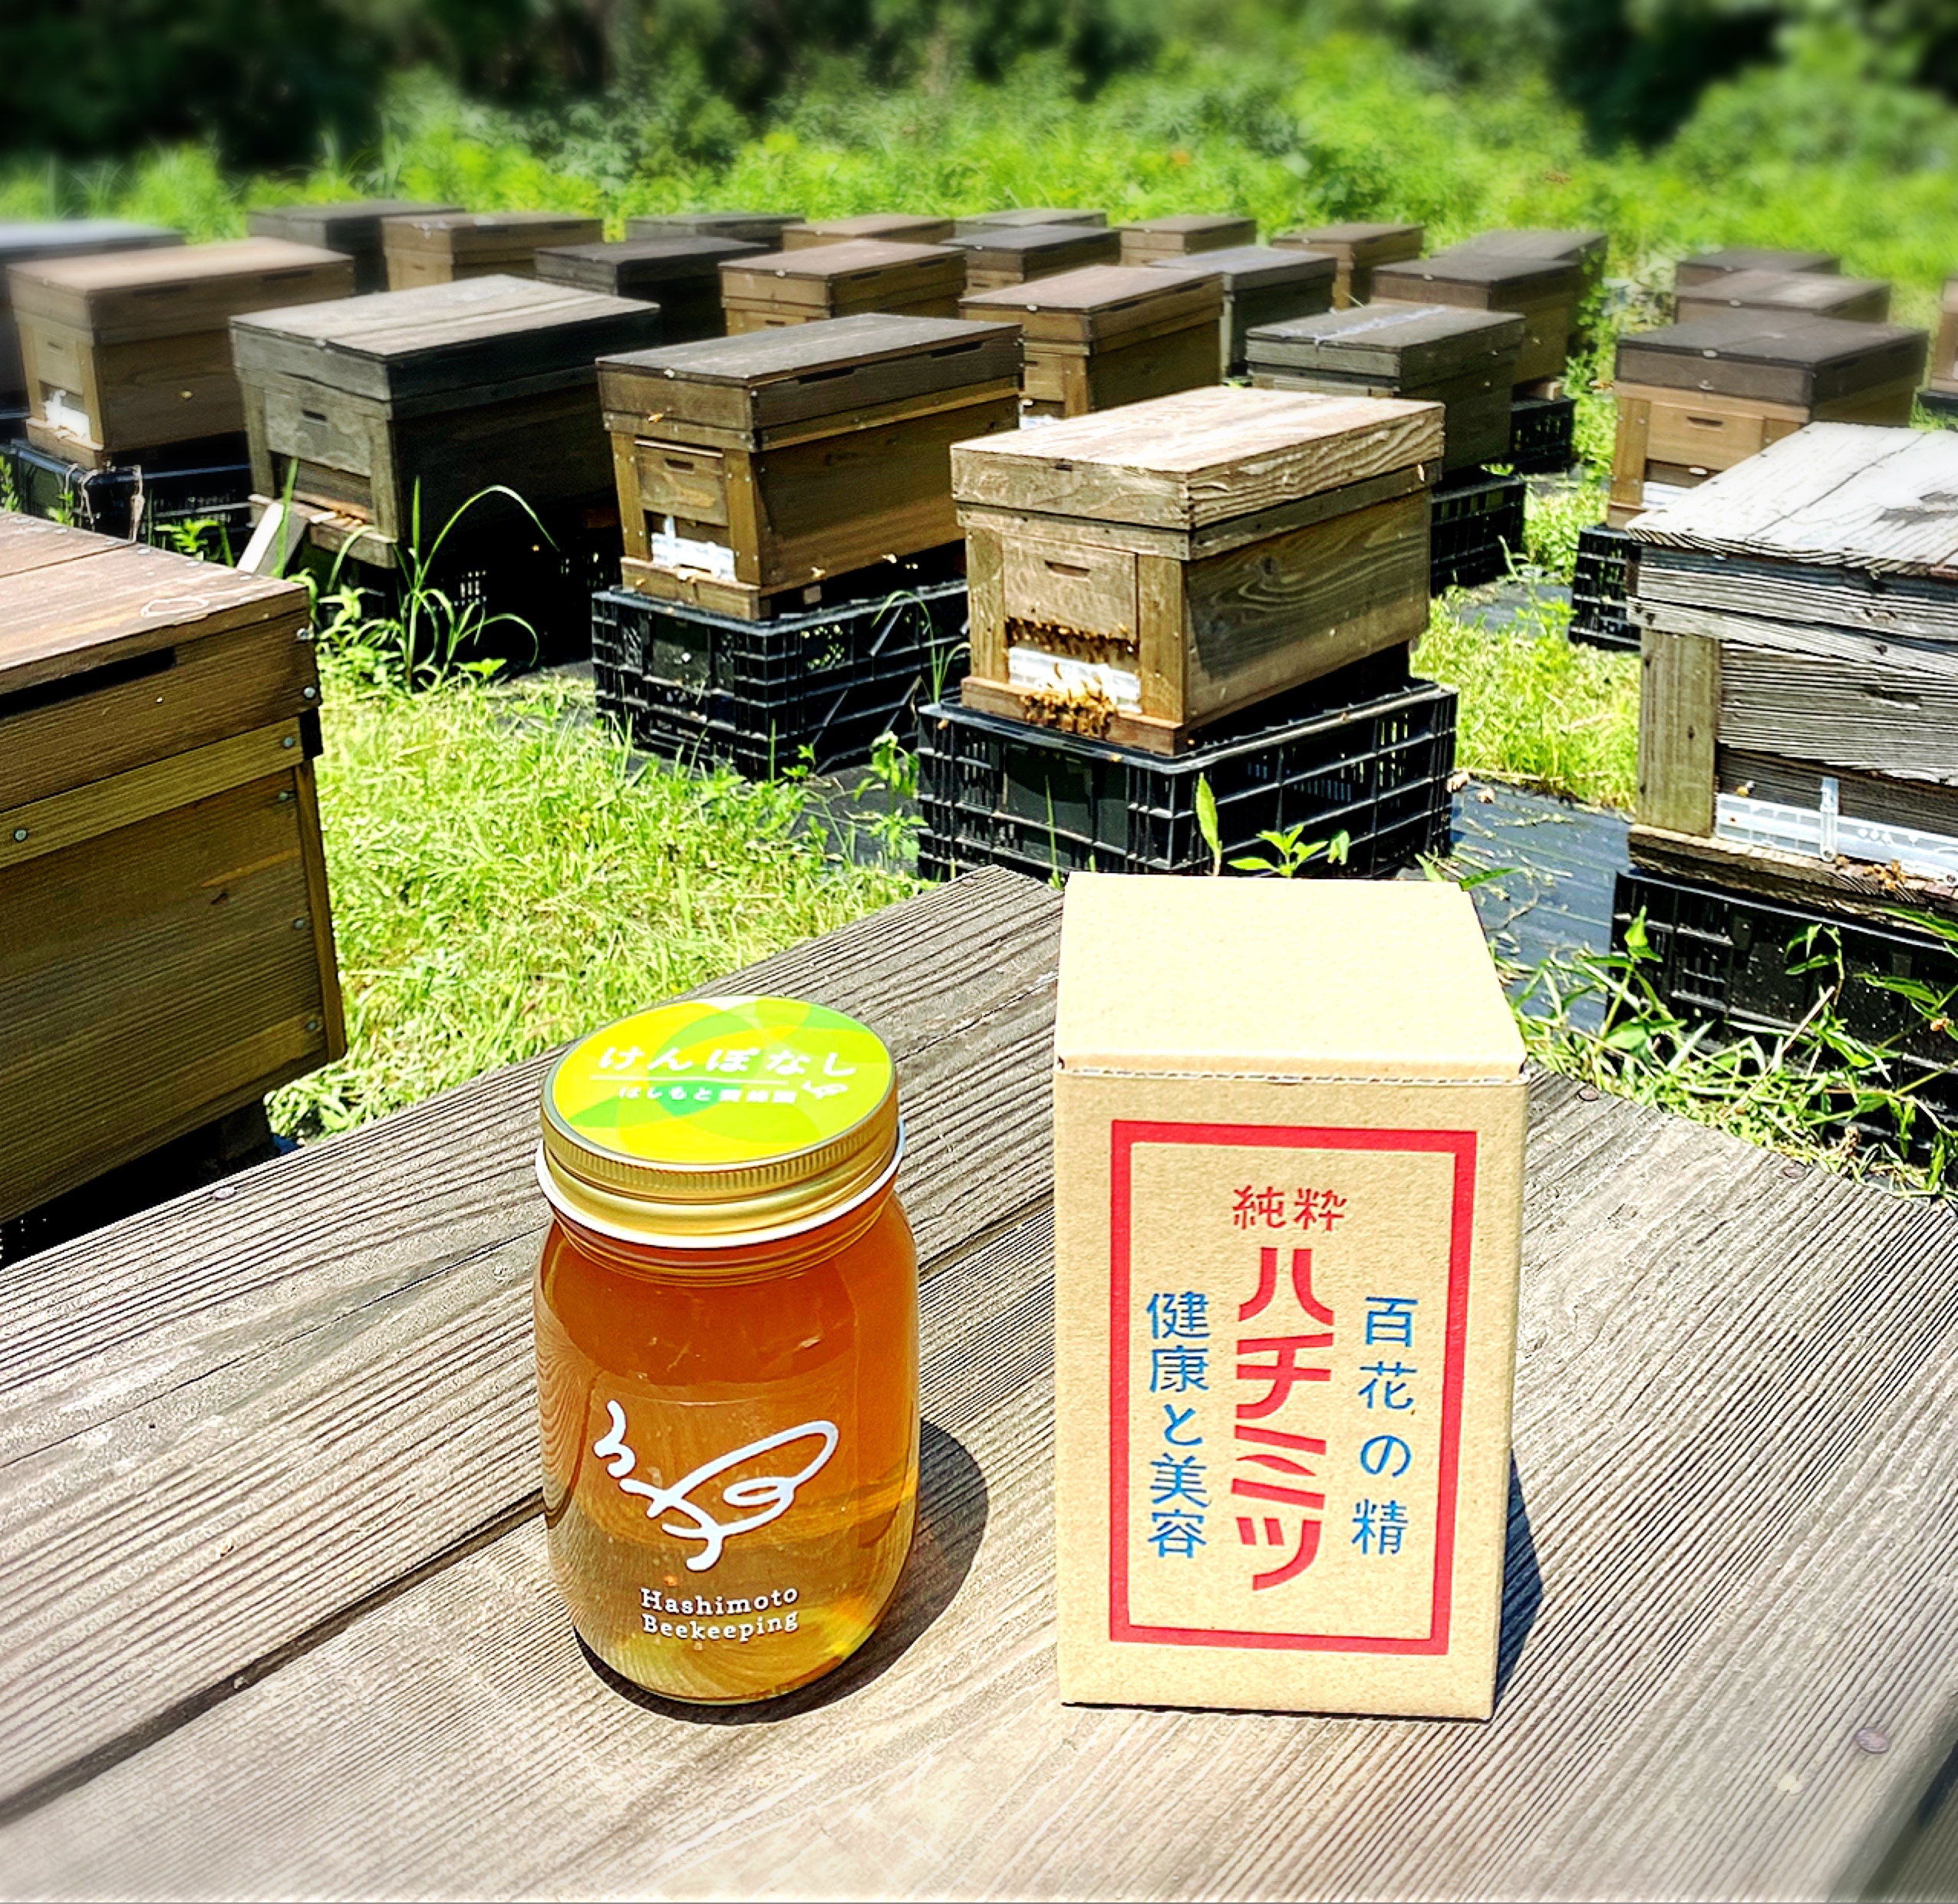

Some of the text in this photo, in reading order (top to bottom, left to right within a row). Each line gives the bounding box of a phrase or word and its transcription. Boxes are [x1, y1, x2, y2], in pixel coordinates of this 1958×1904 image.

[620, 1086, 797, 1104] はしもと
[1232, 1184, 1347, 1231] 純粋
[1146, 1291, 1210, 1559] 健康と美容
[1231, 1247, 1334, 1591] ハチミツ
[1351, 1296, 1419, 1556] 百花の精
[640, 1587, 799, 1616] Hashimoto
[642, 1611, 799, 1642] Beekeeping
